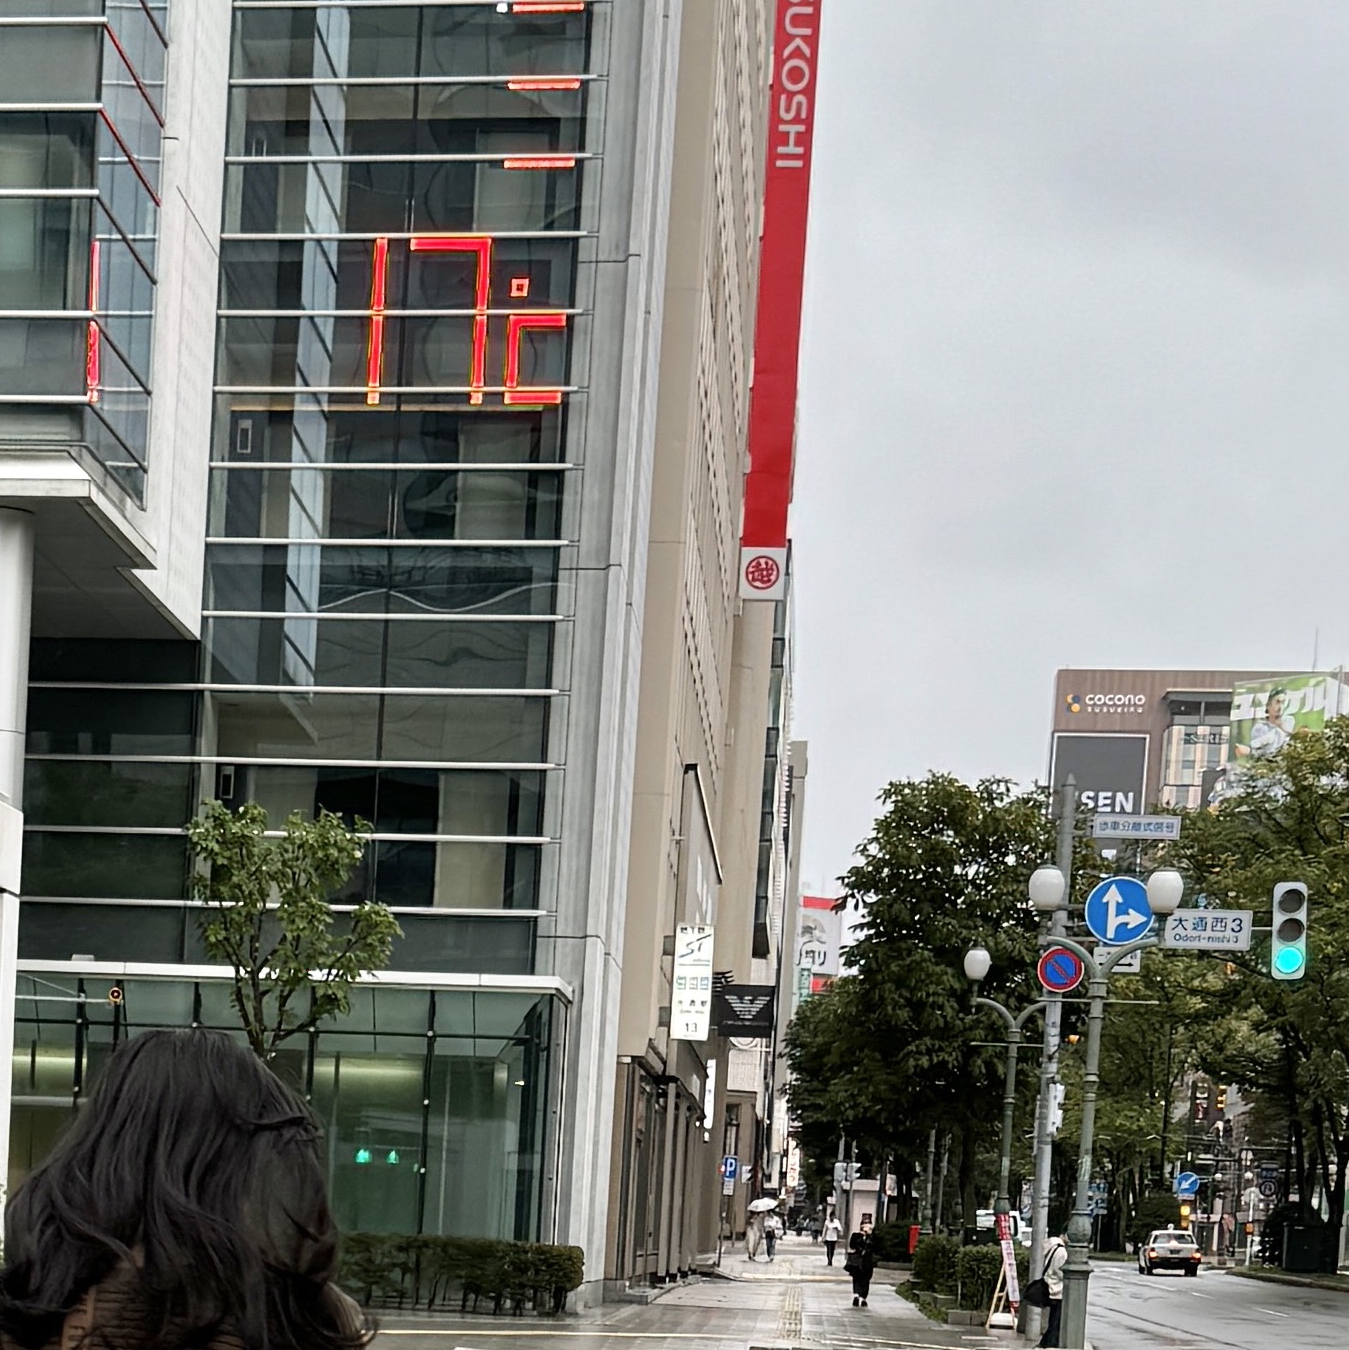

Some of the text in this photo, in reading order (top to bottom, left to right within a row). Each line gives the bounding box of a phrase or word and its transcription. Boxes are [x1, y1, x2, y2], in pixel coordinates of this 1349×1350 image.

[775, 0, 814, 168] UKOSHI
[1075, 790, 1135, 813] SEN
[1171, 917, 1243, 933] 大通西3
[726, 1158, 736, 1177] P
